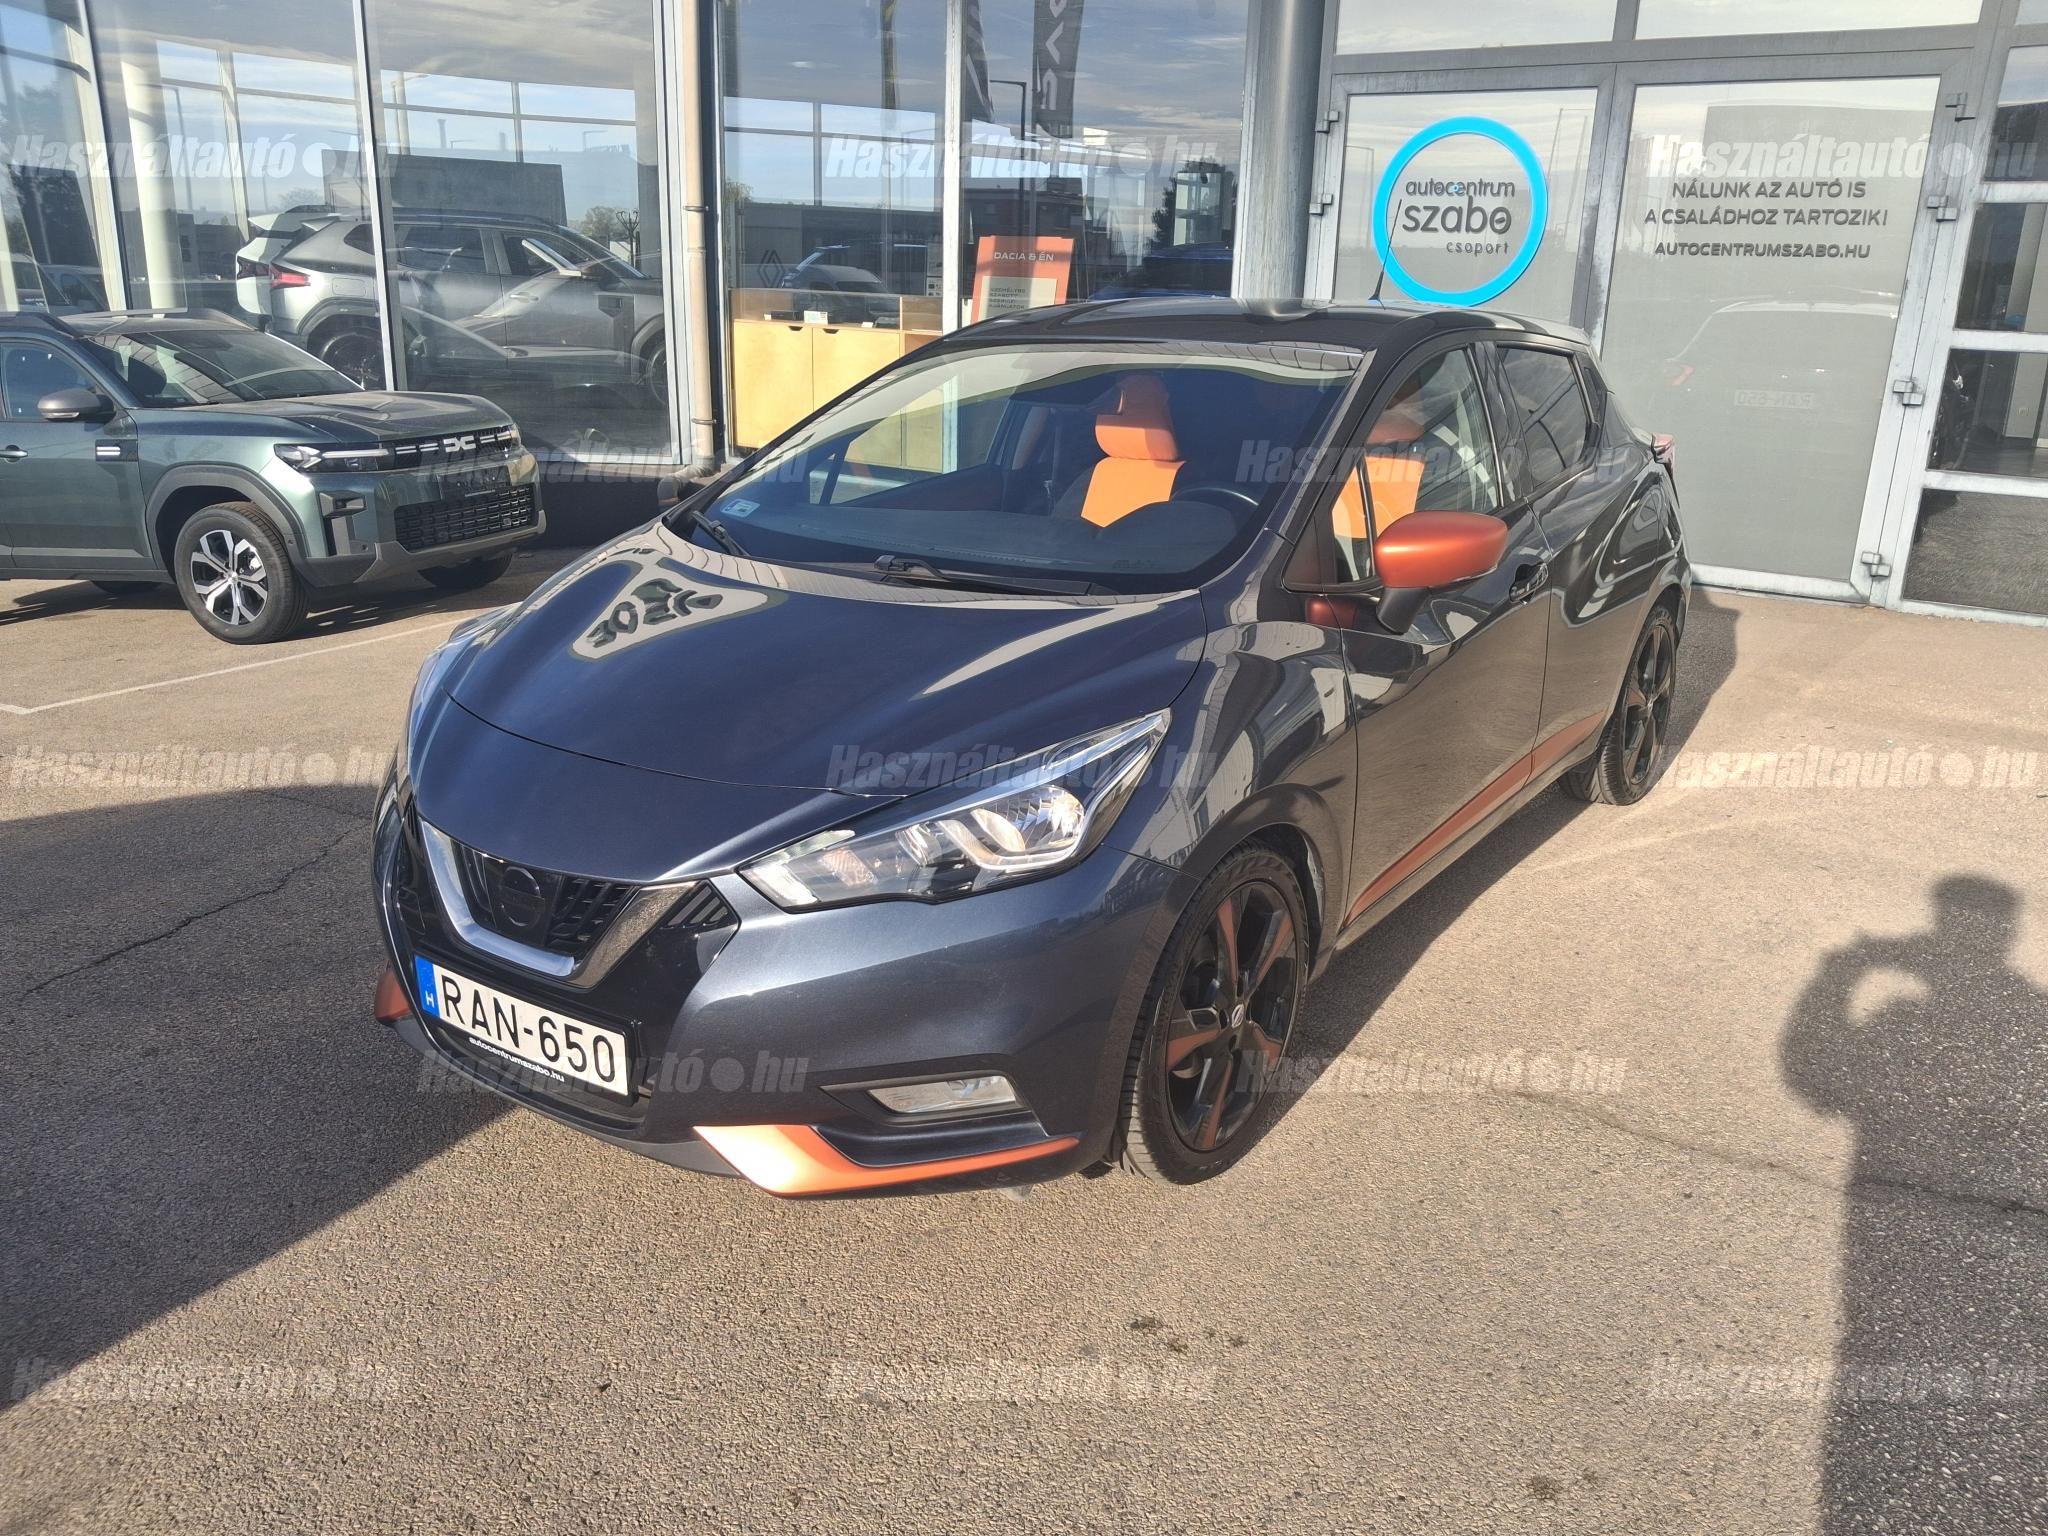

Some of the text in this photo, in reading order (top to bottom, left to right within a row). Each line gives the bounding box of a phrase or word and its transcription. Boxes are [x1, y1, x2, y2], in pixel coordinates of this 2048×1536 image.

[1405, 178, 1515, 197] autocentrum
[1672, 178, 1866, 198] NÁLUNK AZ AUTÓ IS
[1644, 208, 1657, 224] A
[1661, 205, 1779, 225] CSALÁDHOZ
[994, 252, 1025, 260] DACIA
[1039, 251, 1054, 261] ÉN
[1446, 242, 1508, 257] csoport
[1655, 242, 1871, 259] AUTOCENTRUMSZABO.HU
[425, 991, 435, 1008] H
[441, 975, 616, 1083] RAN-650
[469, 1037, 565, 1082] autocentrumszabo.hu
